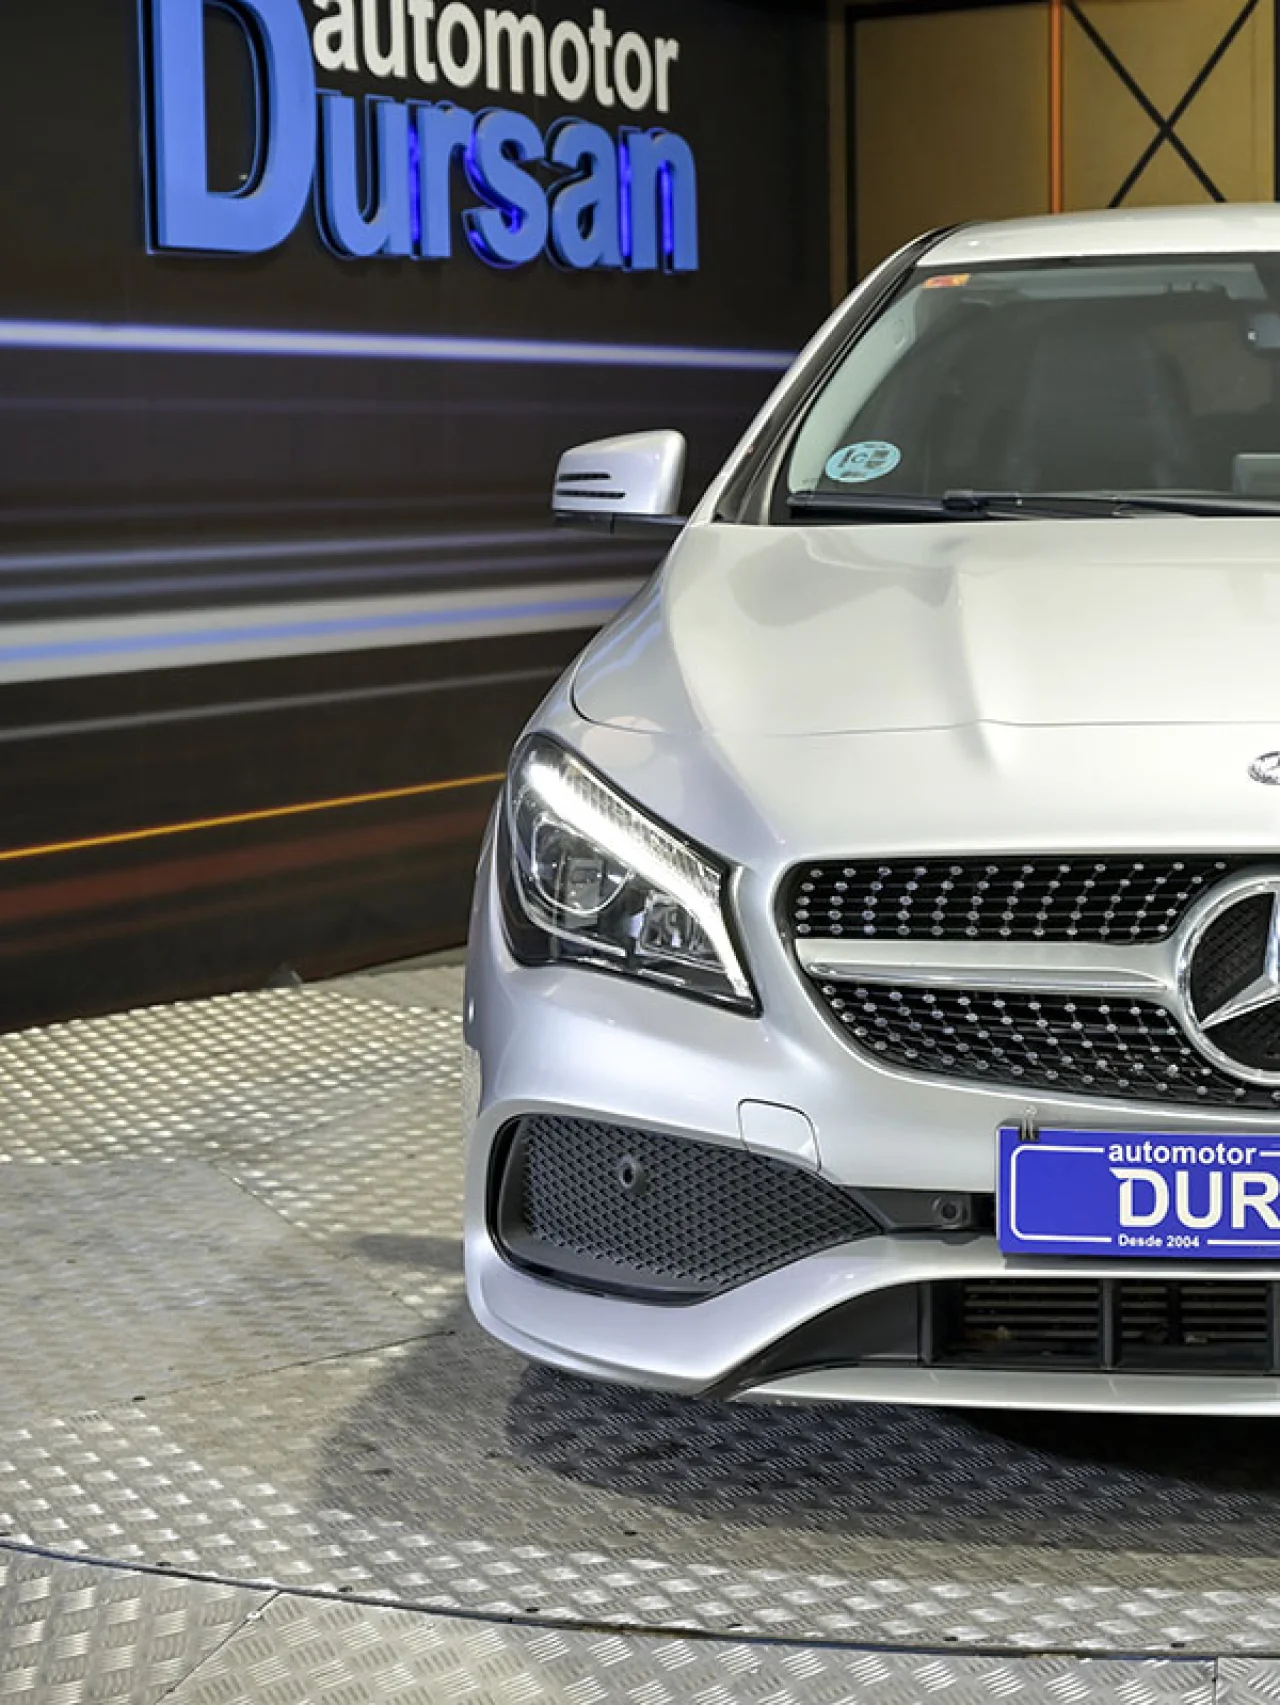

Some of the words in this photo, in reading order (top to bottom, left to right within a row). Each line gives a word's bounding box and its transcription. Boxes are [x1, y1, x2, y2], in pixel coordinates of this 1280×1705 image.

[312, 0, 679, 113] automotor
[145, 0, 699, 272] Dursan
[1108, 1140, 1257, 1165] automotor
[1118, 1233, 1163, 1247] Desde
[1166, 1234, 1200, 1248] 2004
